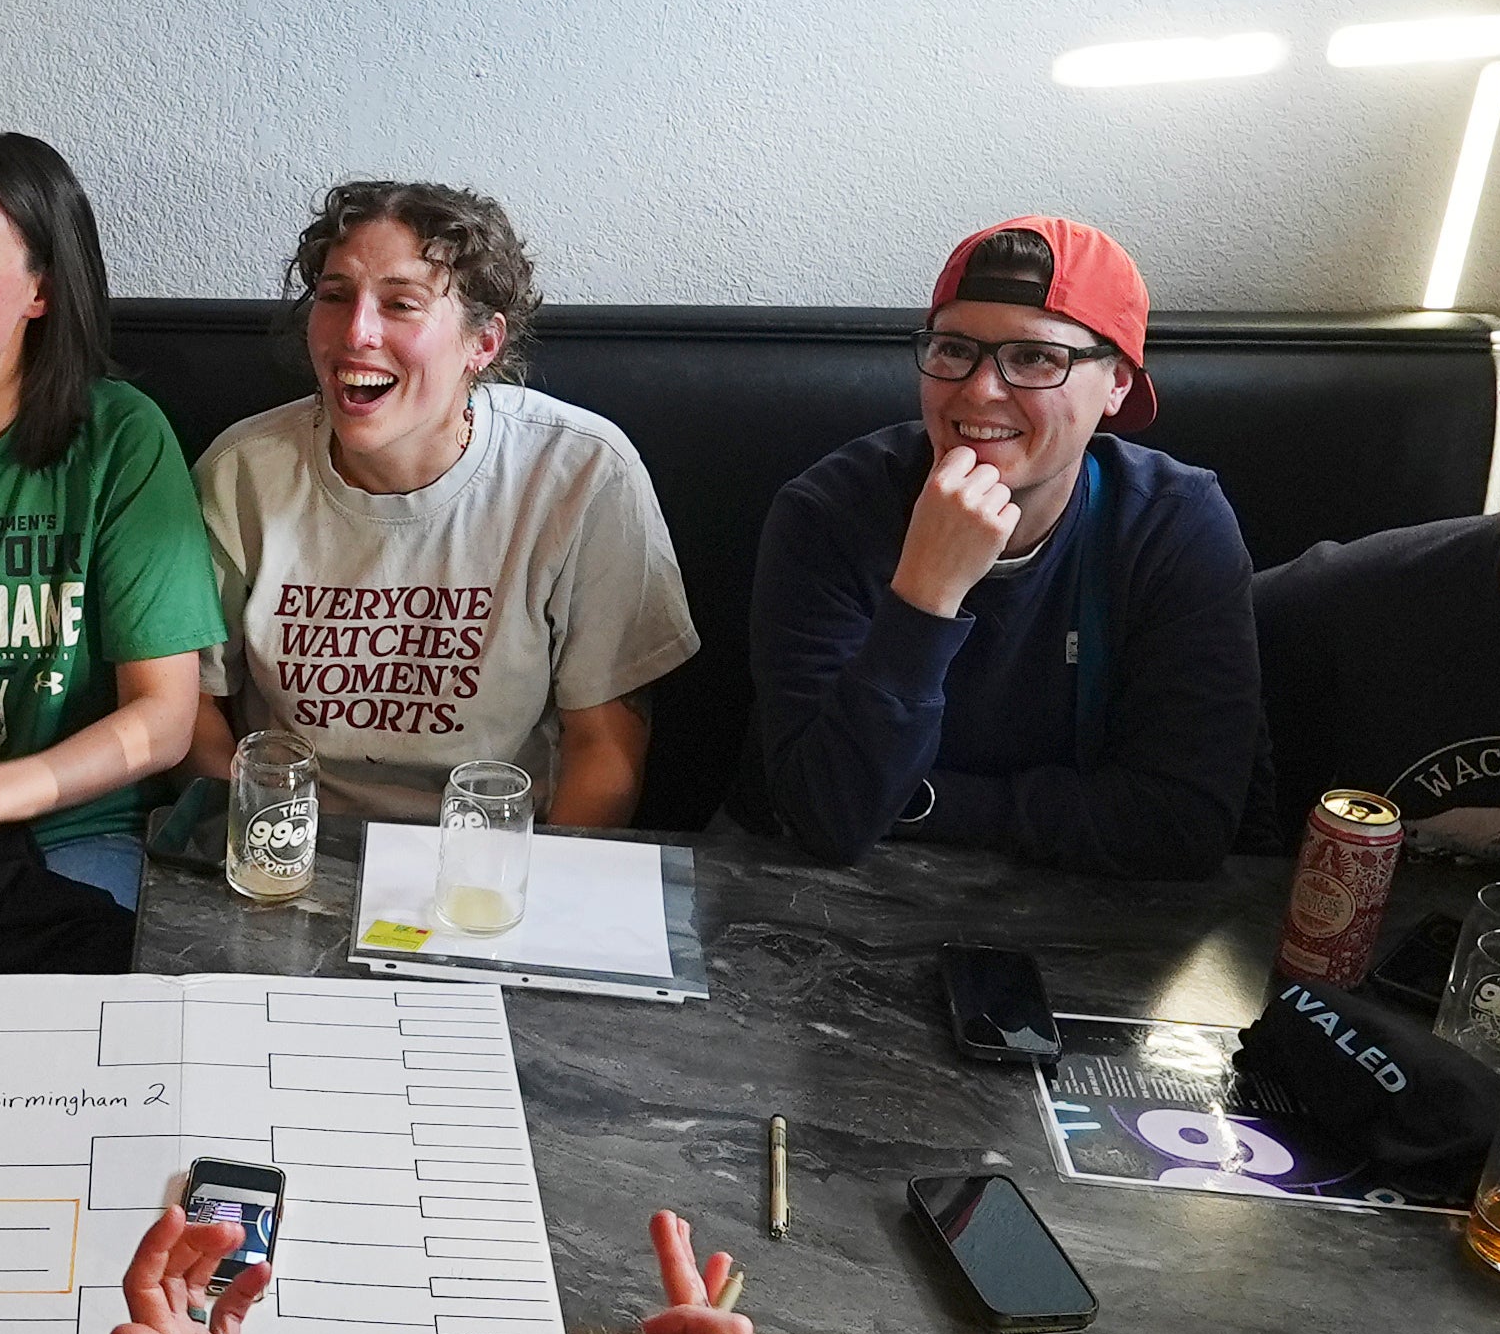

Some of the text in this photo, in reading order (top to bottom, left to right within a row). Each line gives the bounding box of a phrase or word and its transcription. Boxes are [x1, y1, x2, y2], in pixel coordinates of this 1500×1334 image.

[274, 584, 493, 622] EVERYONE
[281, 623, 483, 661] WATCHES
[277, 661, 480, 699] WOMEN'S
[295, 698, 465, 735] SPORTS.
[279, 803, 309, 818] THE
[143, 1083, 170, 1107] 2
